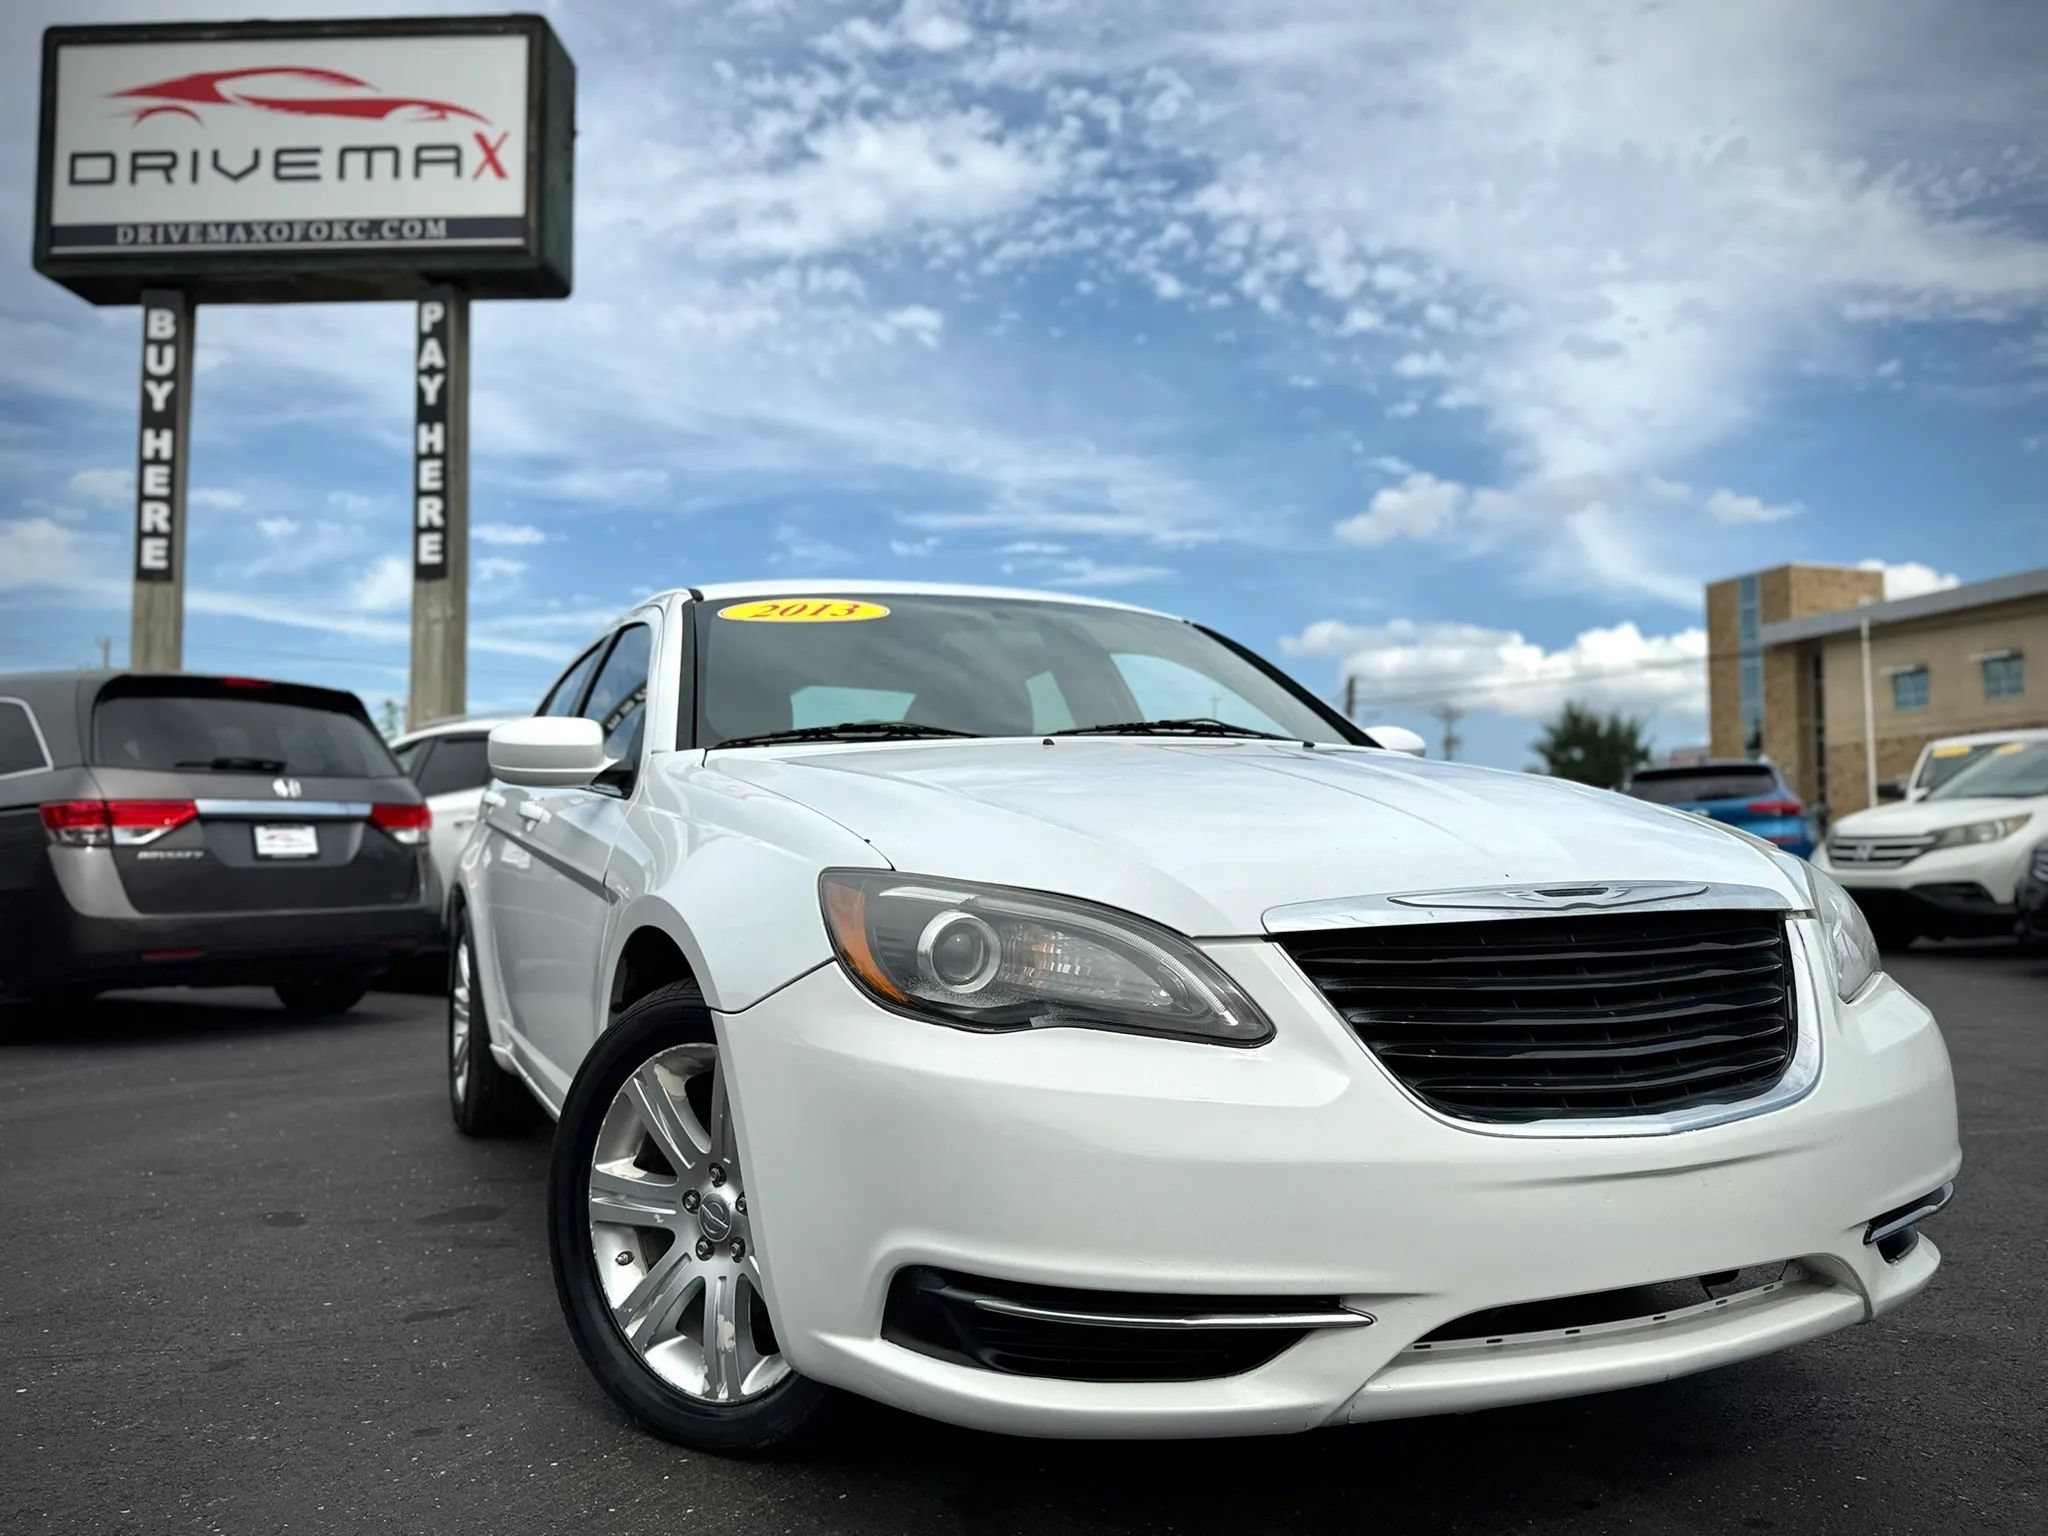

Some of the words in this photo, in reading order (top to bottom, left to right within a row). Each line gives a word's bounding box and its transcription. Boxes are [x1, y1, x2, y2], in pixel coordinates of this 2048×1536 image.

[68, 130, 510, 187] DRIVEMAX
[116, 218, 448, 246] DRIVEMAXOFOKC.COM
[144, 308, 177, 413] BUY
[417, 301, 447, 407] PAY
[140, 428, 174, 570] HERE
[417, 421, 446, 565] HERE
[749, 602, 861, 618] 2013
